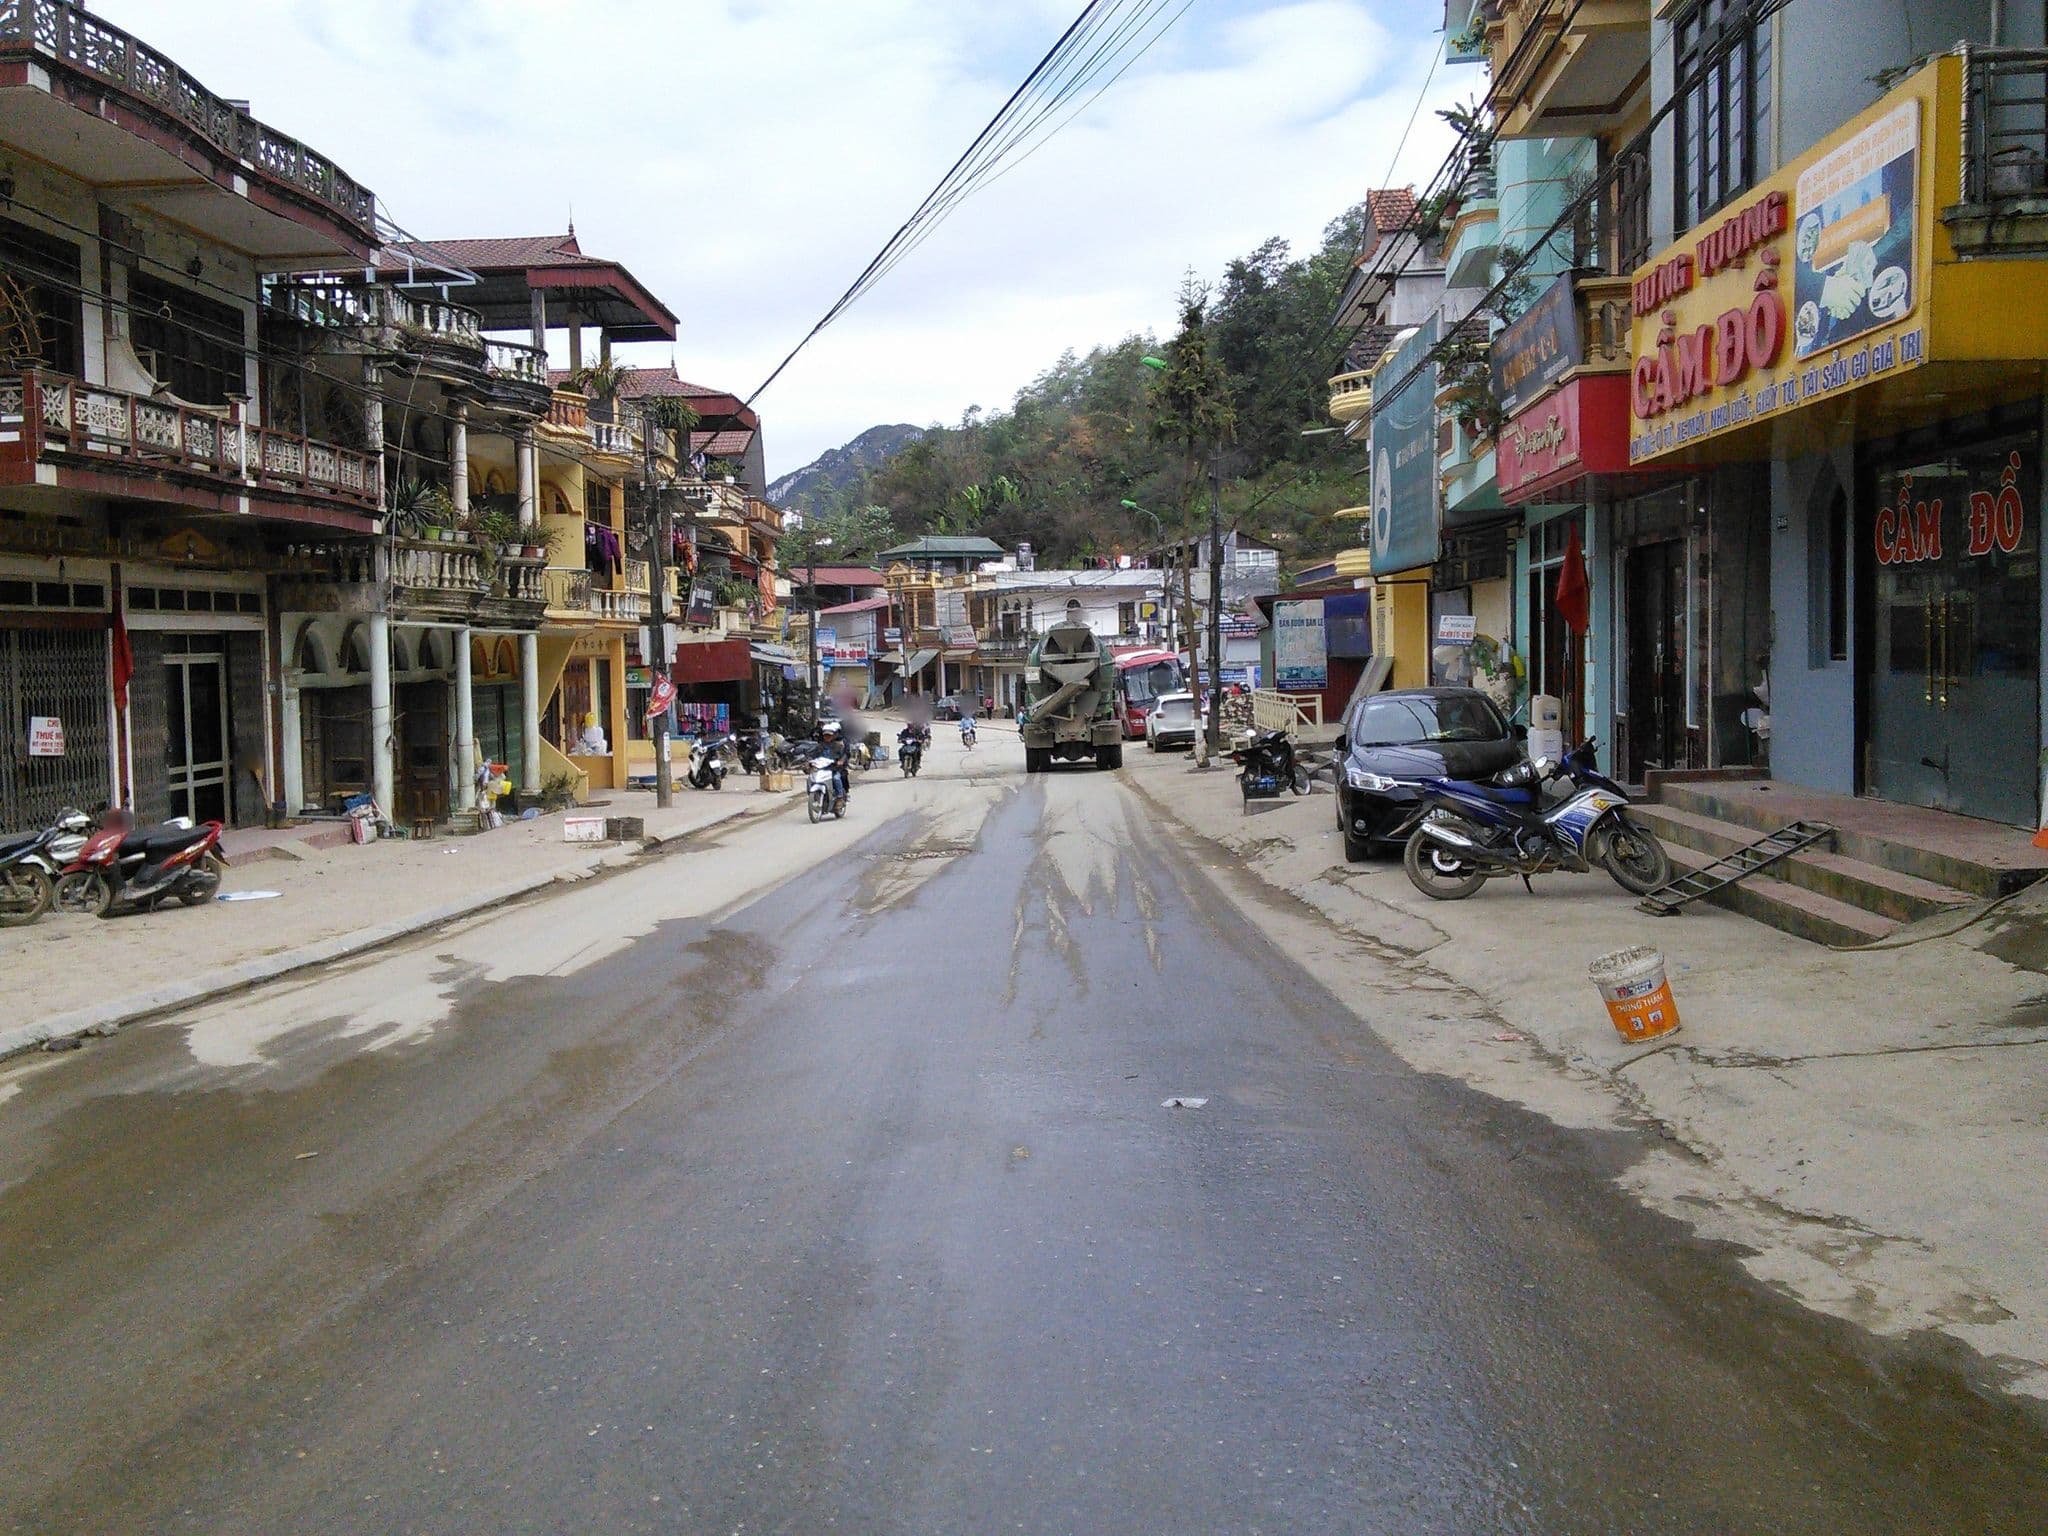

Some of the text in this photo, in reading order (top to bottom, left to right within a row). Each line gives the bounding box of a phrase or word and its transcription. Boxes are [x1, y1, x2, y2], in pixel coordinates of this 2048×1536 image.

[1633, 310, 1714, 419] CẦM
[1716, 248, 1787, 386] ĐỒ
[1823, 350, 1850, 392] SẢN
[1851, 344, 1870, 381] CÓ
[1872, 335, 1896, 374] GIÁ
[1899, 328, 1924, 366] TRỊ
[1875, 451, 2023, 566] CẦM ĐỒ
